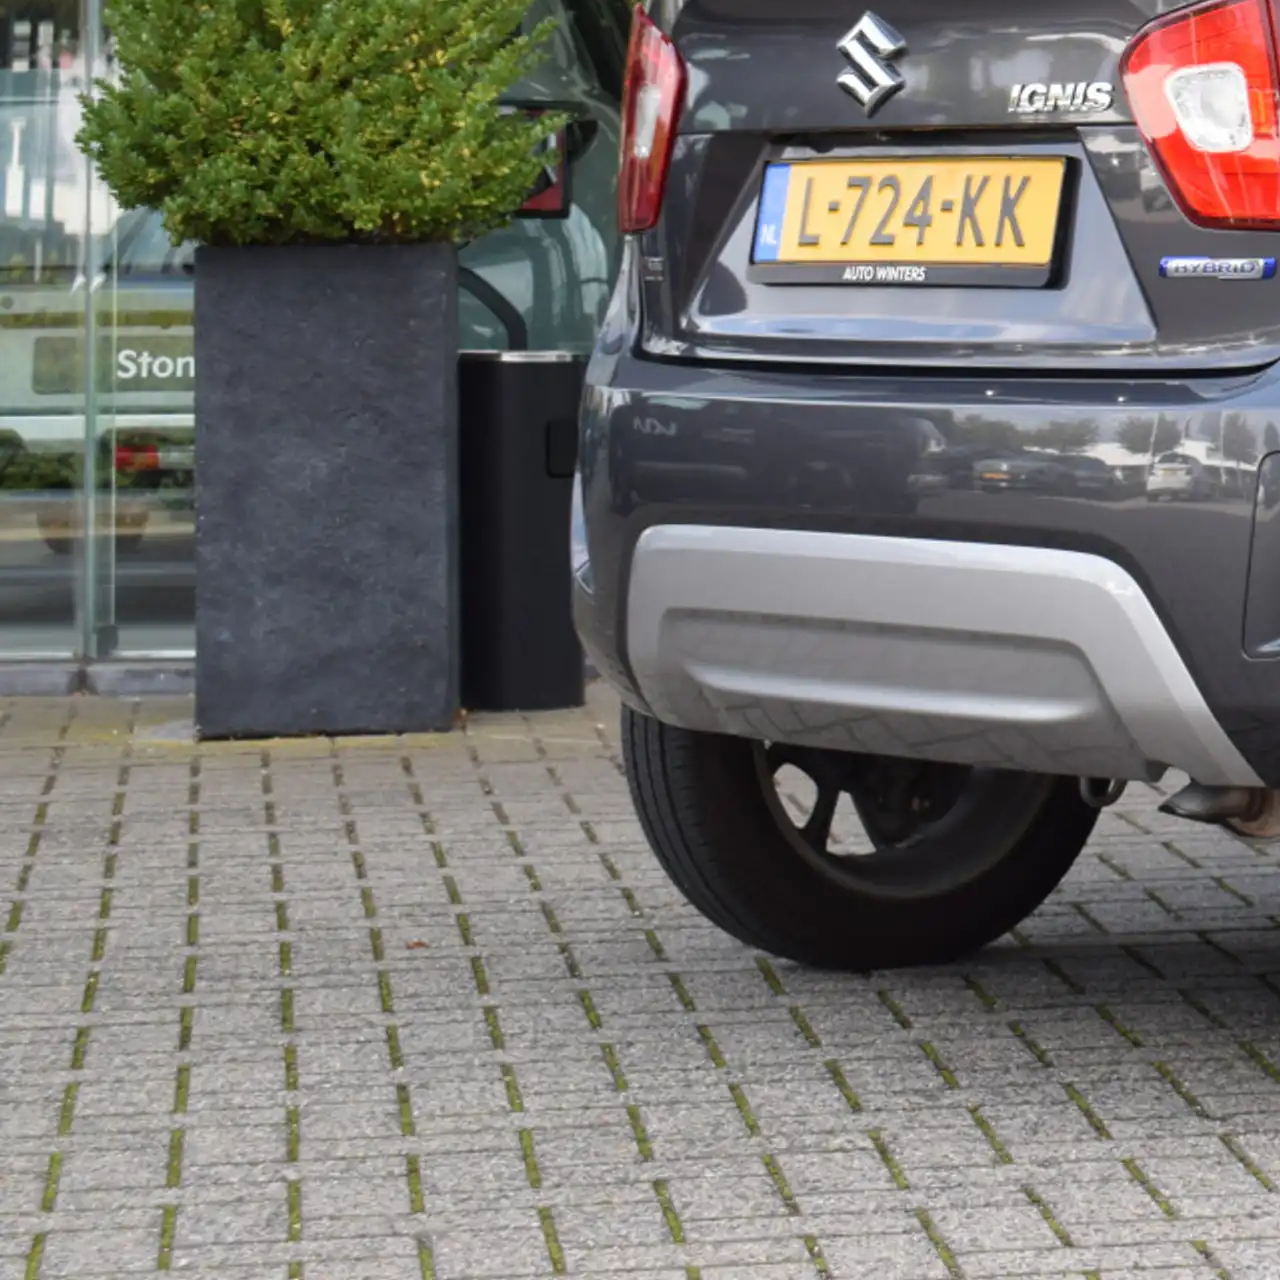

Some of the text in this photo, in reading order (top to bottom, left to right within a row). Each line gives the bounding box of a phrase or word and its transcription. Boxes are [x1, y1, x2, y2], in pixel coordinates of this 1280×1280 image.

[1007, 81, 1115, 114] IGNIS
[796, 173, 1032, 248] L-724-KK
[759, 223, 777, 246] NL
[841, 266, 927, 282] AUTO WINTERS
[1173, 260, 1256, 274] HYBRID
